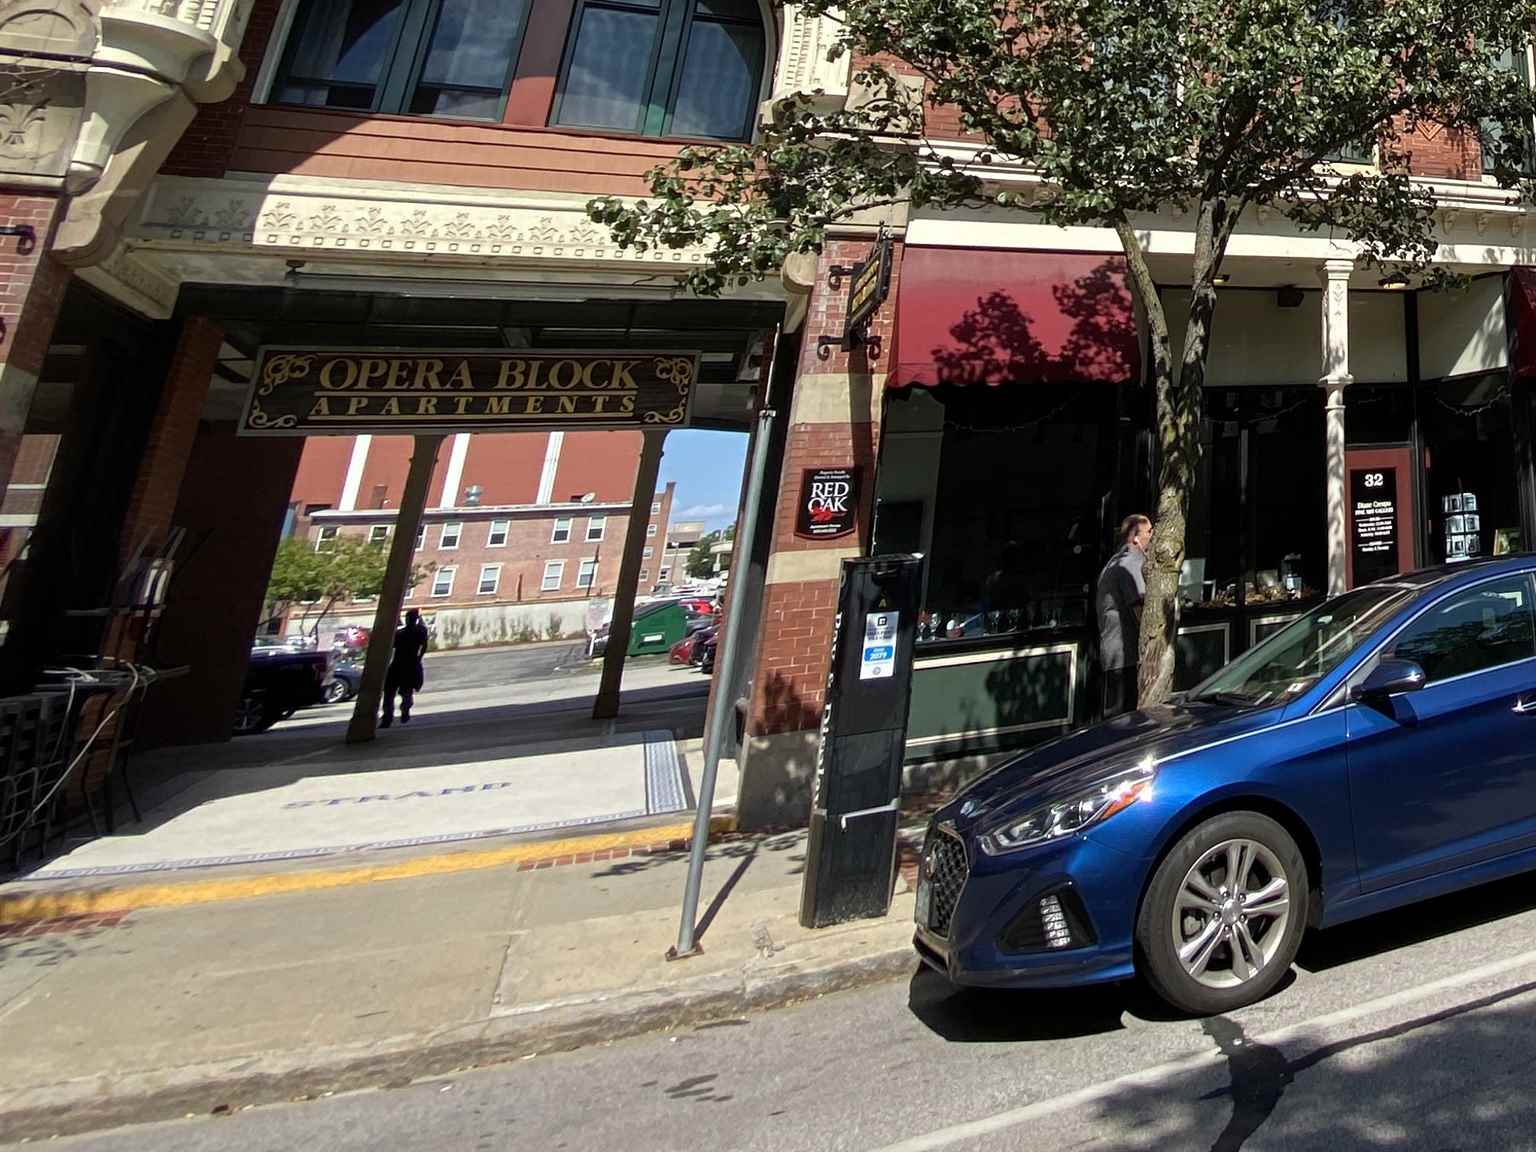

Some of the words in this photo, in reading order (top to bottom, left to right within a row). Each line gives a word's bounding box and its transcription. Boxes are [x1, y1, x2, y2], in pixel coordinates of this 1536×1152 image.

[318, 356, 474, 391] OPERA
[492, 357, 642, 390] BLOCK
[309, 393, 638, 416] APARTMENTS
[1364, 473, 1384, 487] 32
[810, 481, 850, 499] RED
[807, 496, 848, 514] OAK
